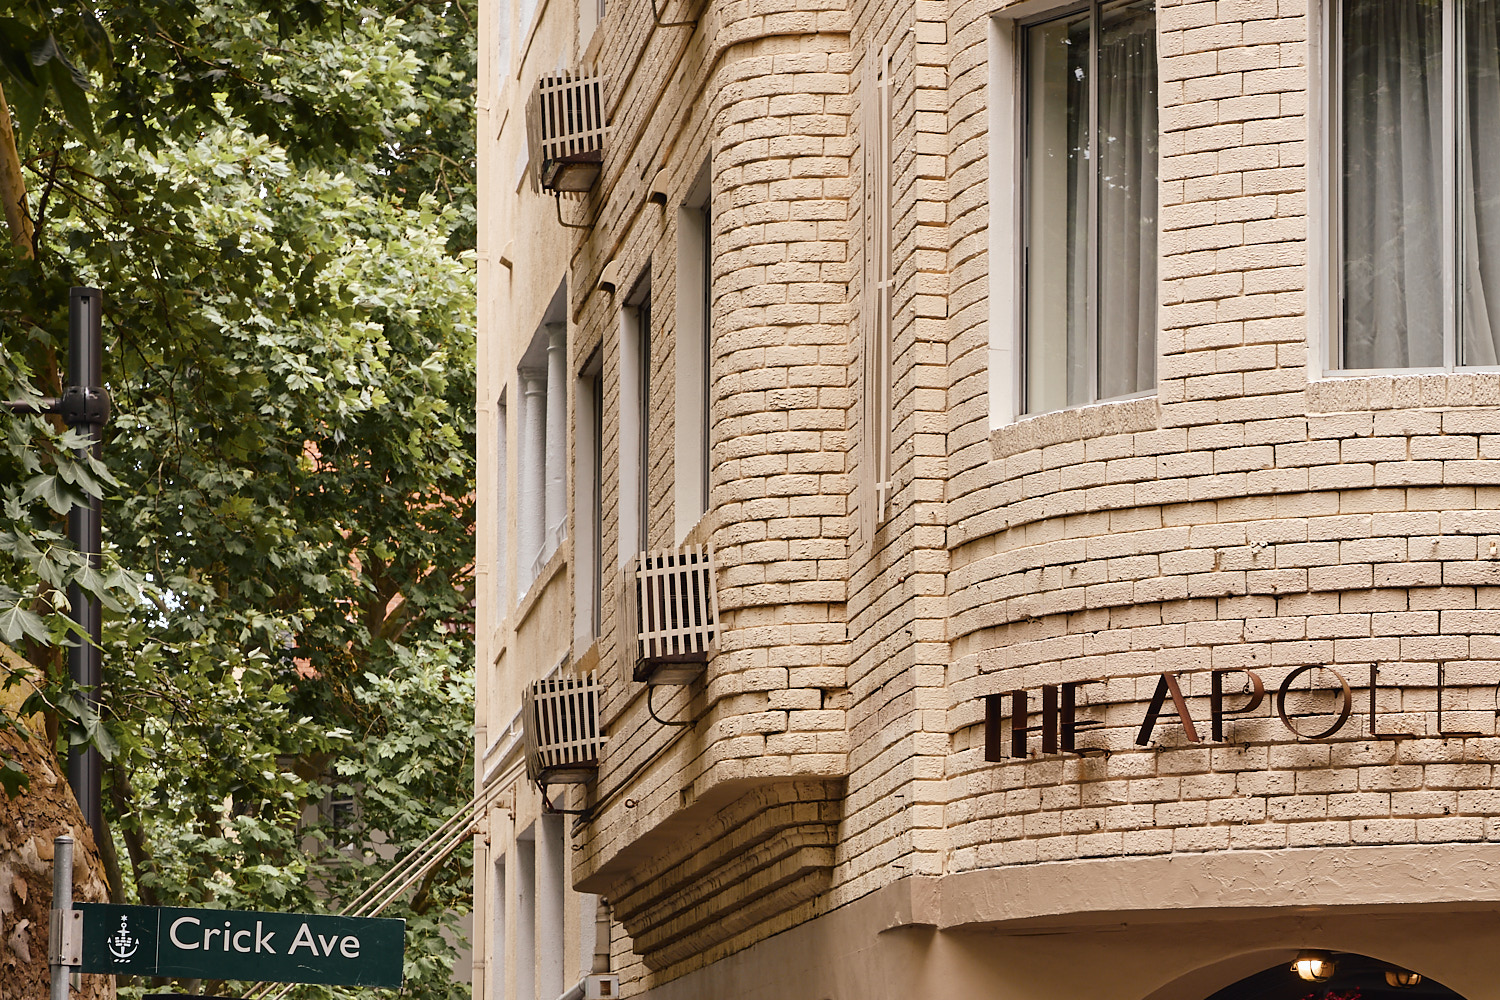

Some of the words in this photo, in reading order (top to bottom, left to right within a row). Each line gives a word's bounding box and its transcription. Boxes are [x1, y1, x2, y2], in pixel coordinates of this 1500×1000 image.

[984, 679, 1107, 763] THE
[169, 916, 277, 955] Crick
[288, 921, 361, 958] Ave
